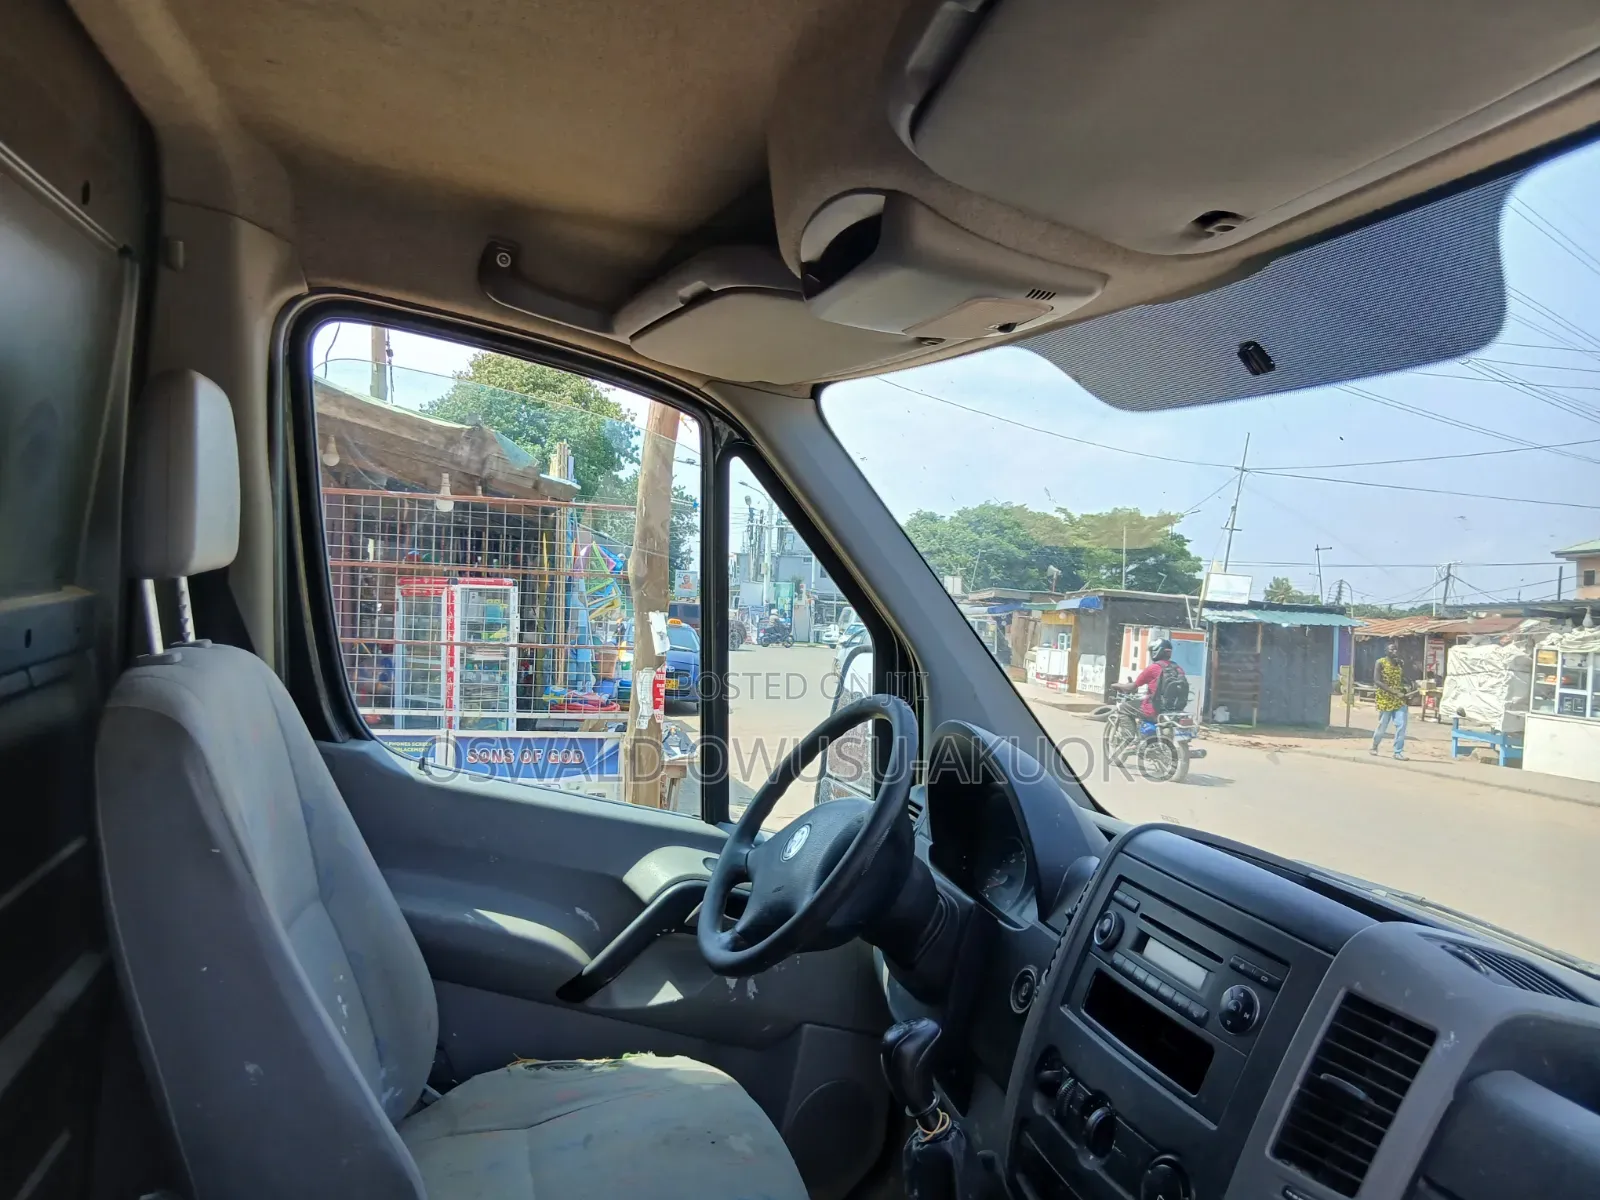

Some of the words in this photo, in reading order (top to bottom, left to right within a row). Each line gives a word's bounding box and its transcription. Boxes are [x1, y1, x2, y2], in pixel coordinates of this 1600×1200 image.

[467, 748, 515, 764] SONS
[520, 748, 544, 764] OF
[547, 748, 585, 764] GOD
